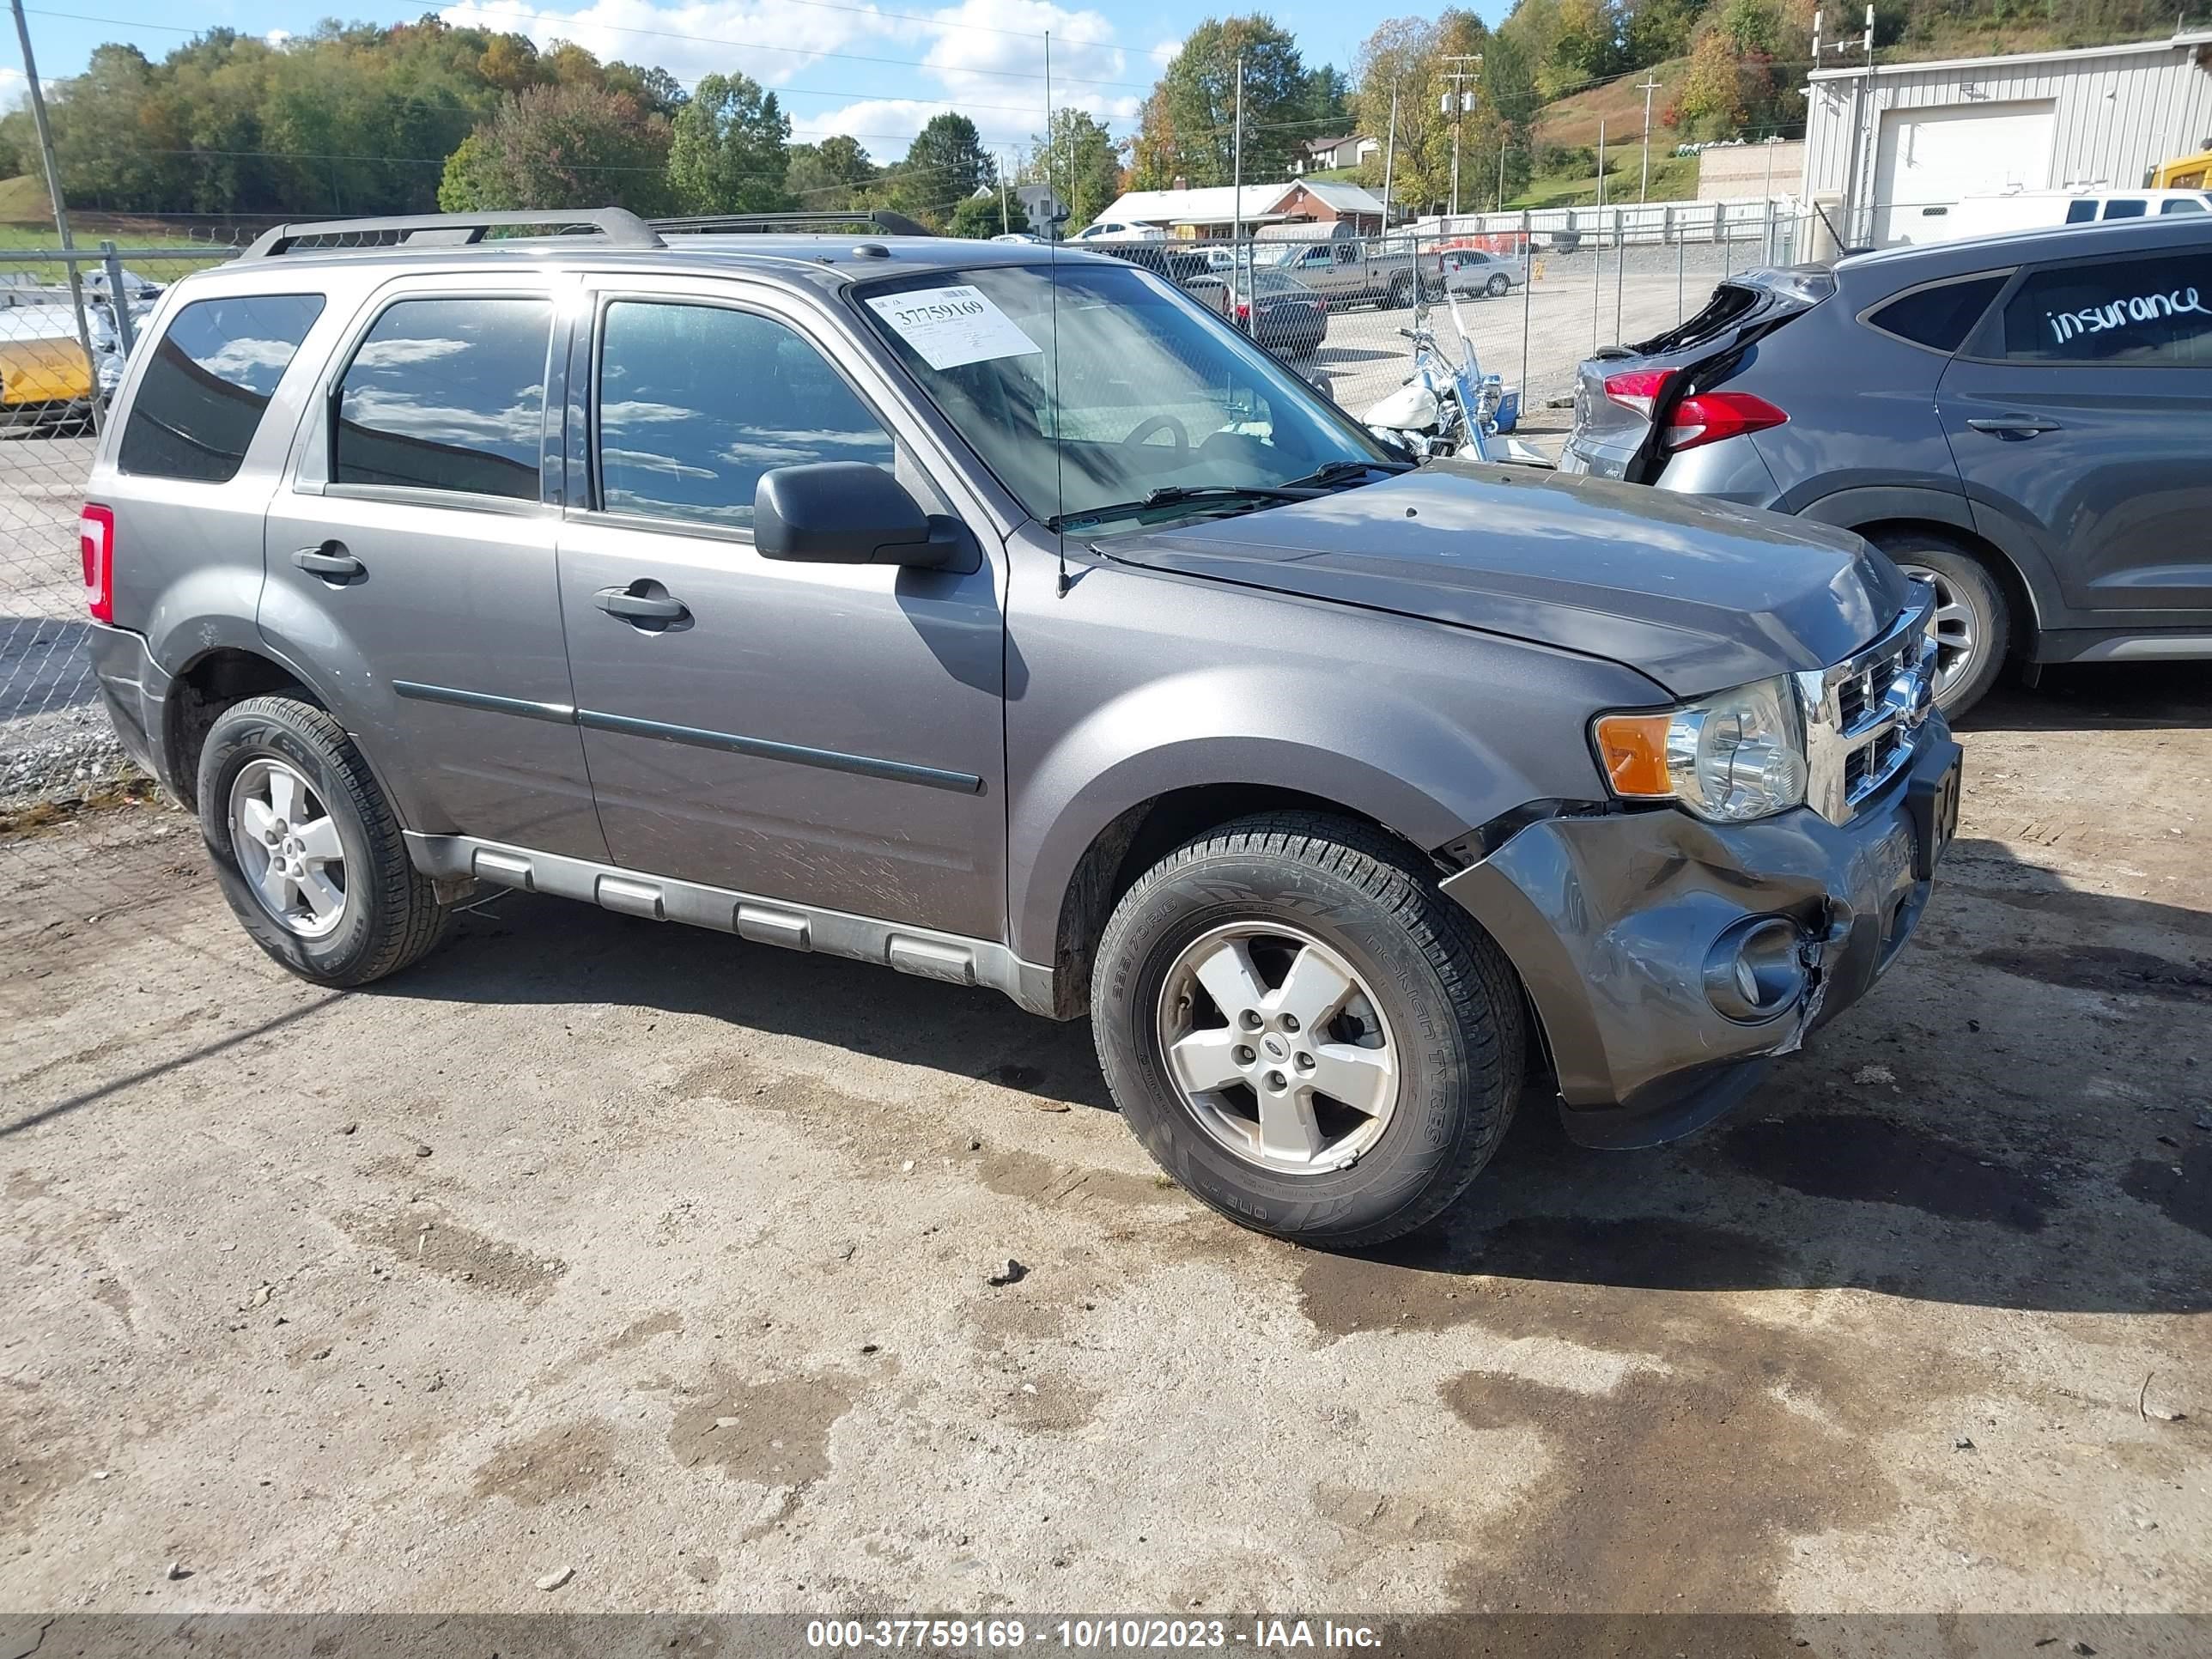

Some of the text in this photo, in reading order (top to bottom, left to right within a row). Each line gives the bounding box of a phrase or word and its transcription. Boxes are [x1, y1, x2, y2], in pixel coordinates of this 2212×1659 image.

[895, 301, 984, 326] 37759169
[2046, 287, 2212, 344] insurance
[1111, 897, 1178, 1003] 235/70R16
[1364, 933, 1437, 1041] nokian
[1423, 1049, 1448, 1145] TYRES
